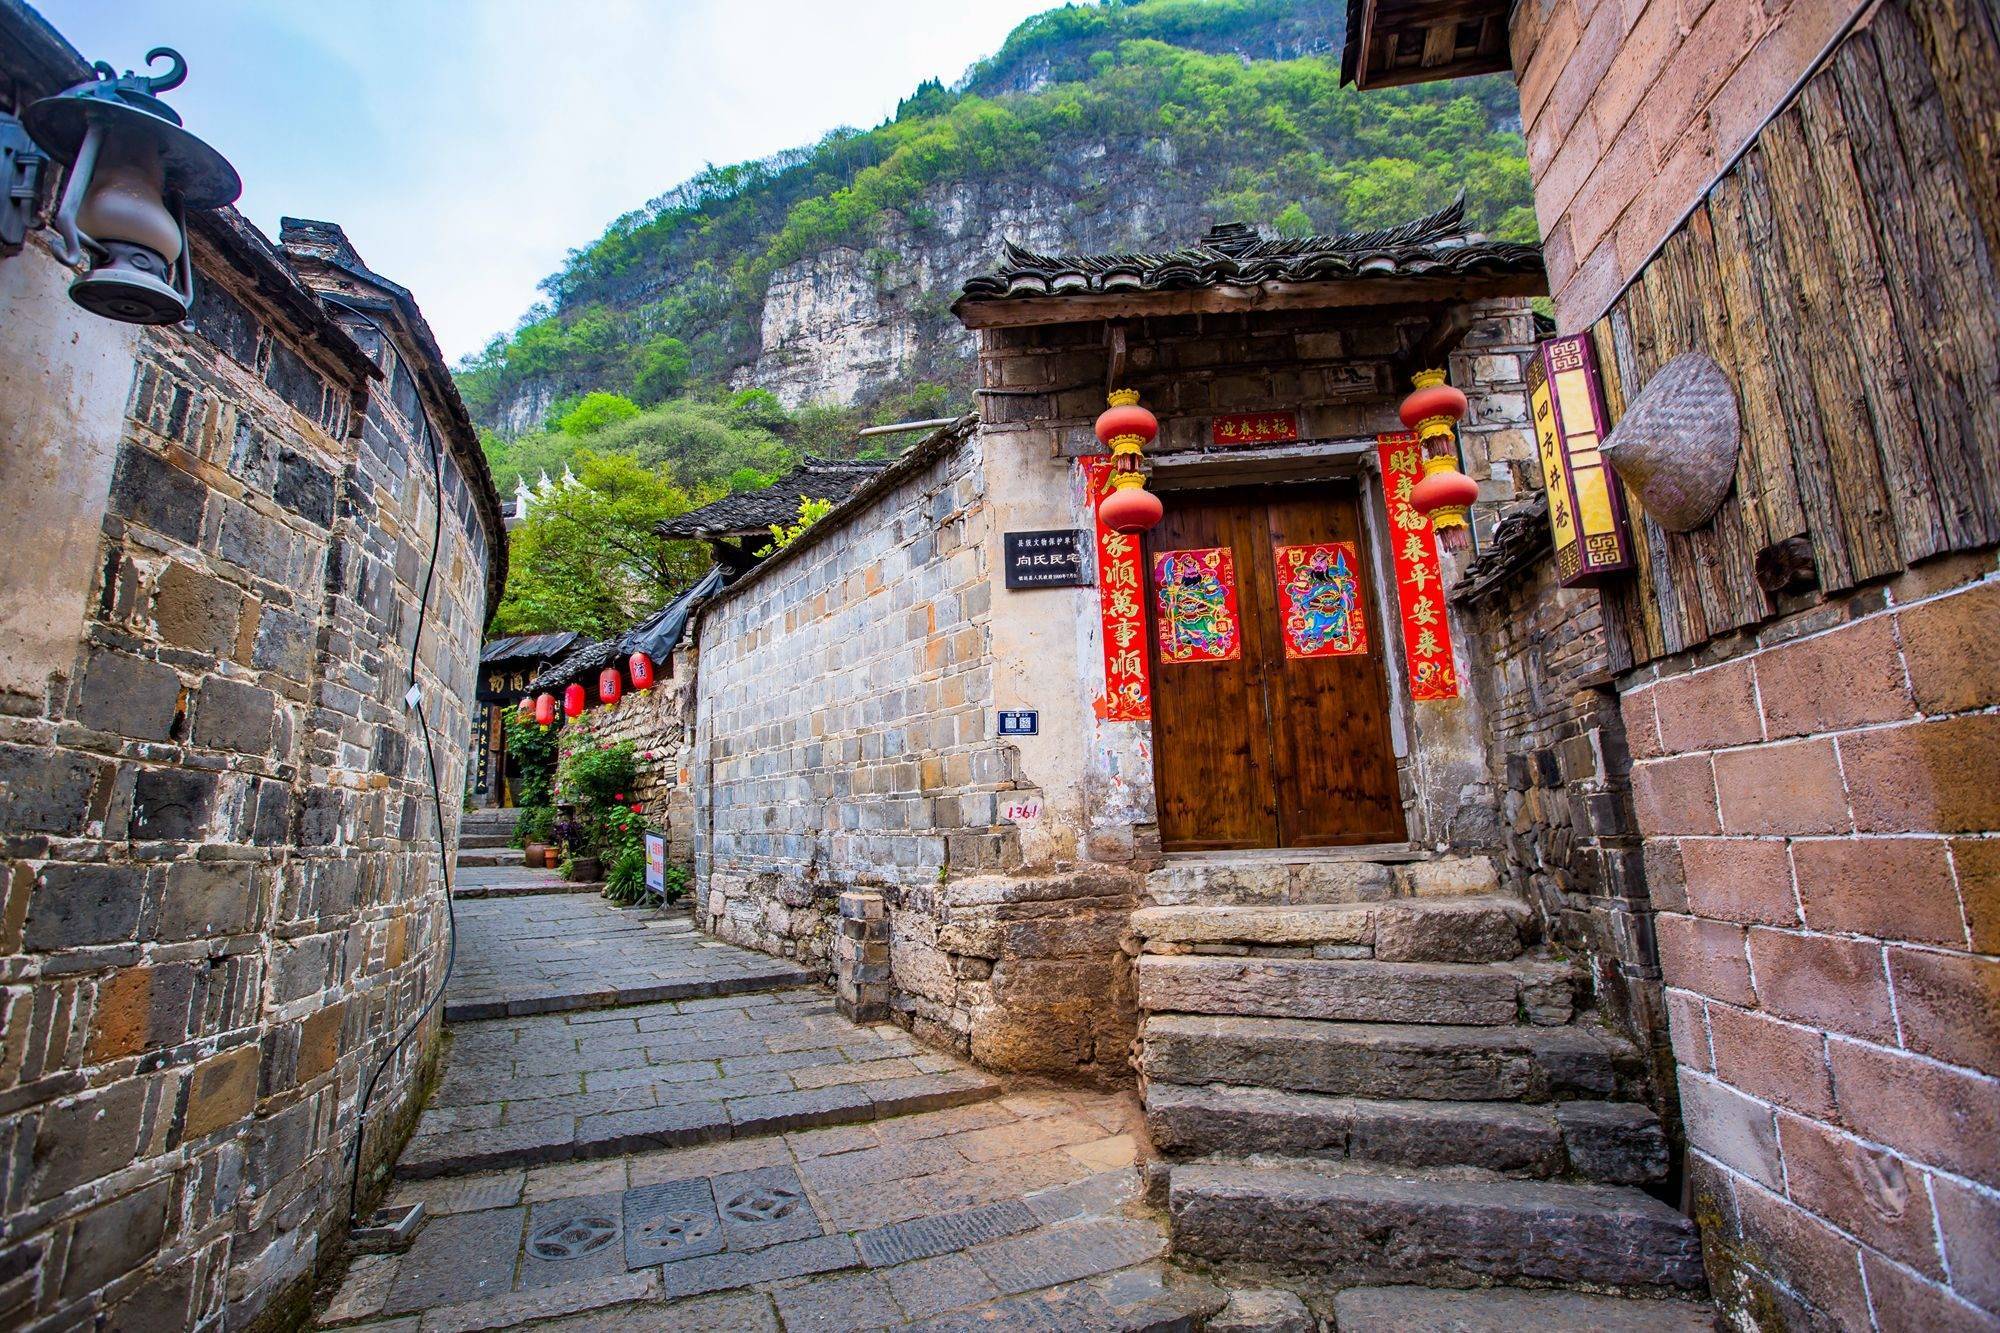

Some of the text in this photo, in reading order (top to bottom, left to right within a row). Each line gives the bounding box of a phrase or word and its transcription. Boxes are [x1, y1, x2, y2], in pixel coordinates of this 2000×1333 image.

[1537, 400, 1569, 529] 四方井巷
[1016, 553, 1080, 566] 向氏民宅
[634, 662, 646, 679] 酒
[604, 680, 615, 695] 酒
[1008, 805, 1037, 818] 1361
